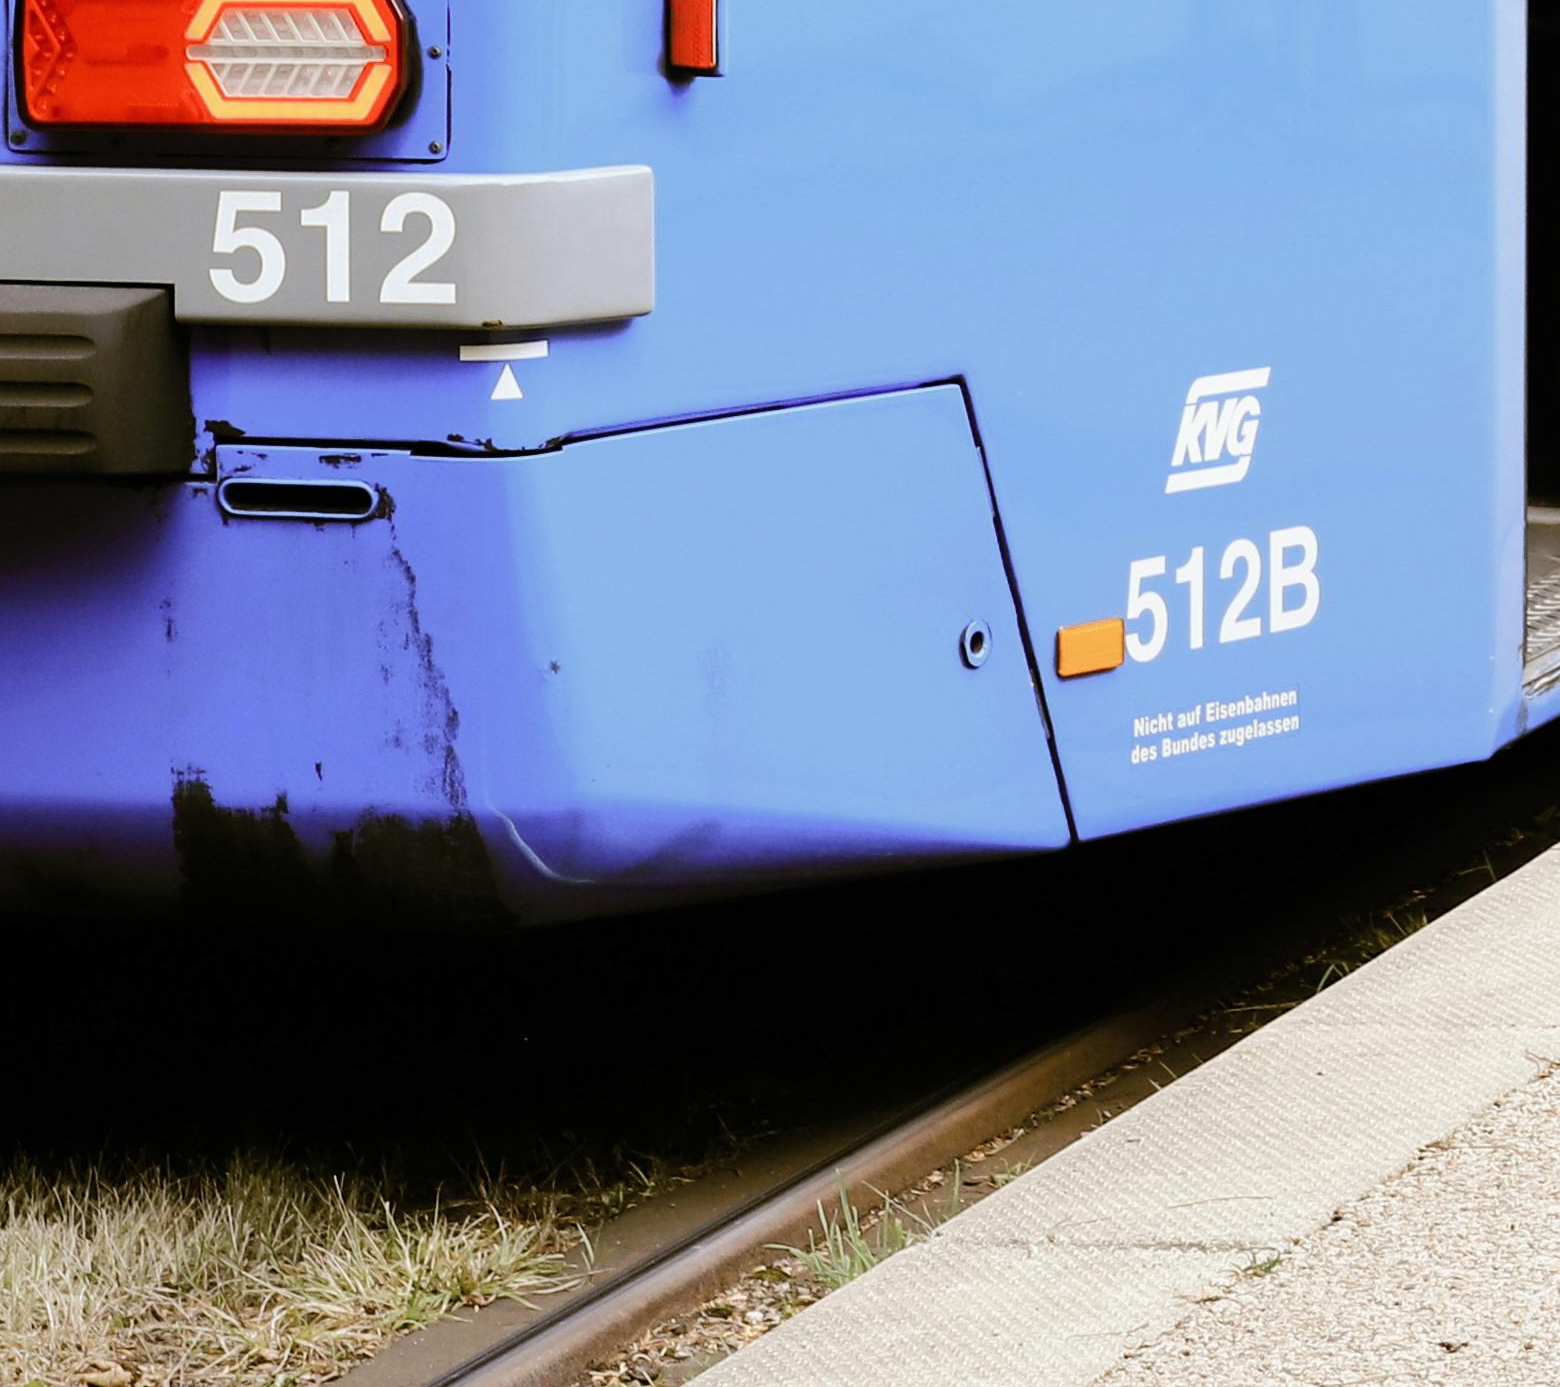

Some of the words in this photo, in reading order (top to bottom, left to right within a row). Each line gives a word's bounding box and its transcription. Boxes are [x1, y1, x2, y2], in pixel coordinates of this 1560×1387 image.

[208, 189, 458, 307] 512
[1170, 395, 1262, 467] KVG
[1124, 525, 1321, 663] 512B
[1130, 743, 1158, 765] des
[1161, 731, 1217, 758] Bundes
[1218, 714, 1301, 747] zugelassen
[1133, 711, 1174, 739] Nicht
[1176, 704, 1202, 729] auf
[1205, 689, 1298, 723] Eisenbahnen
